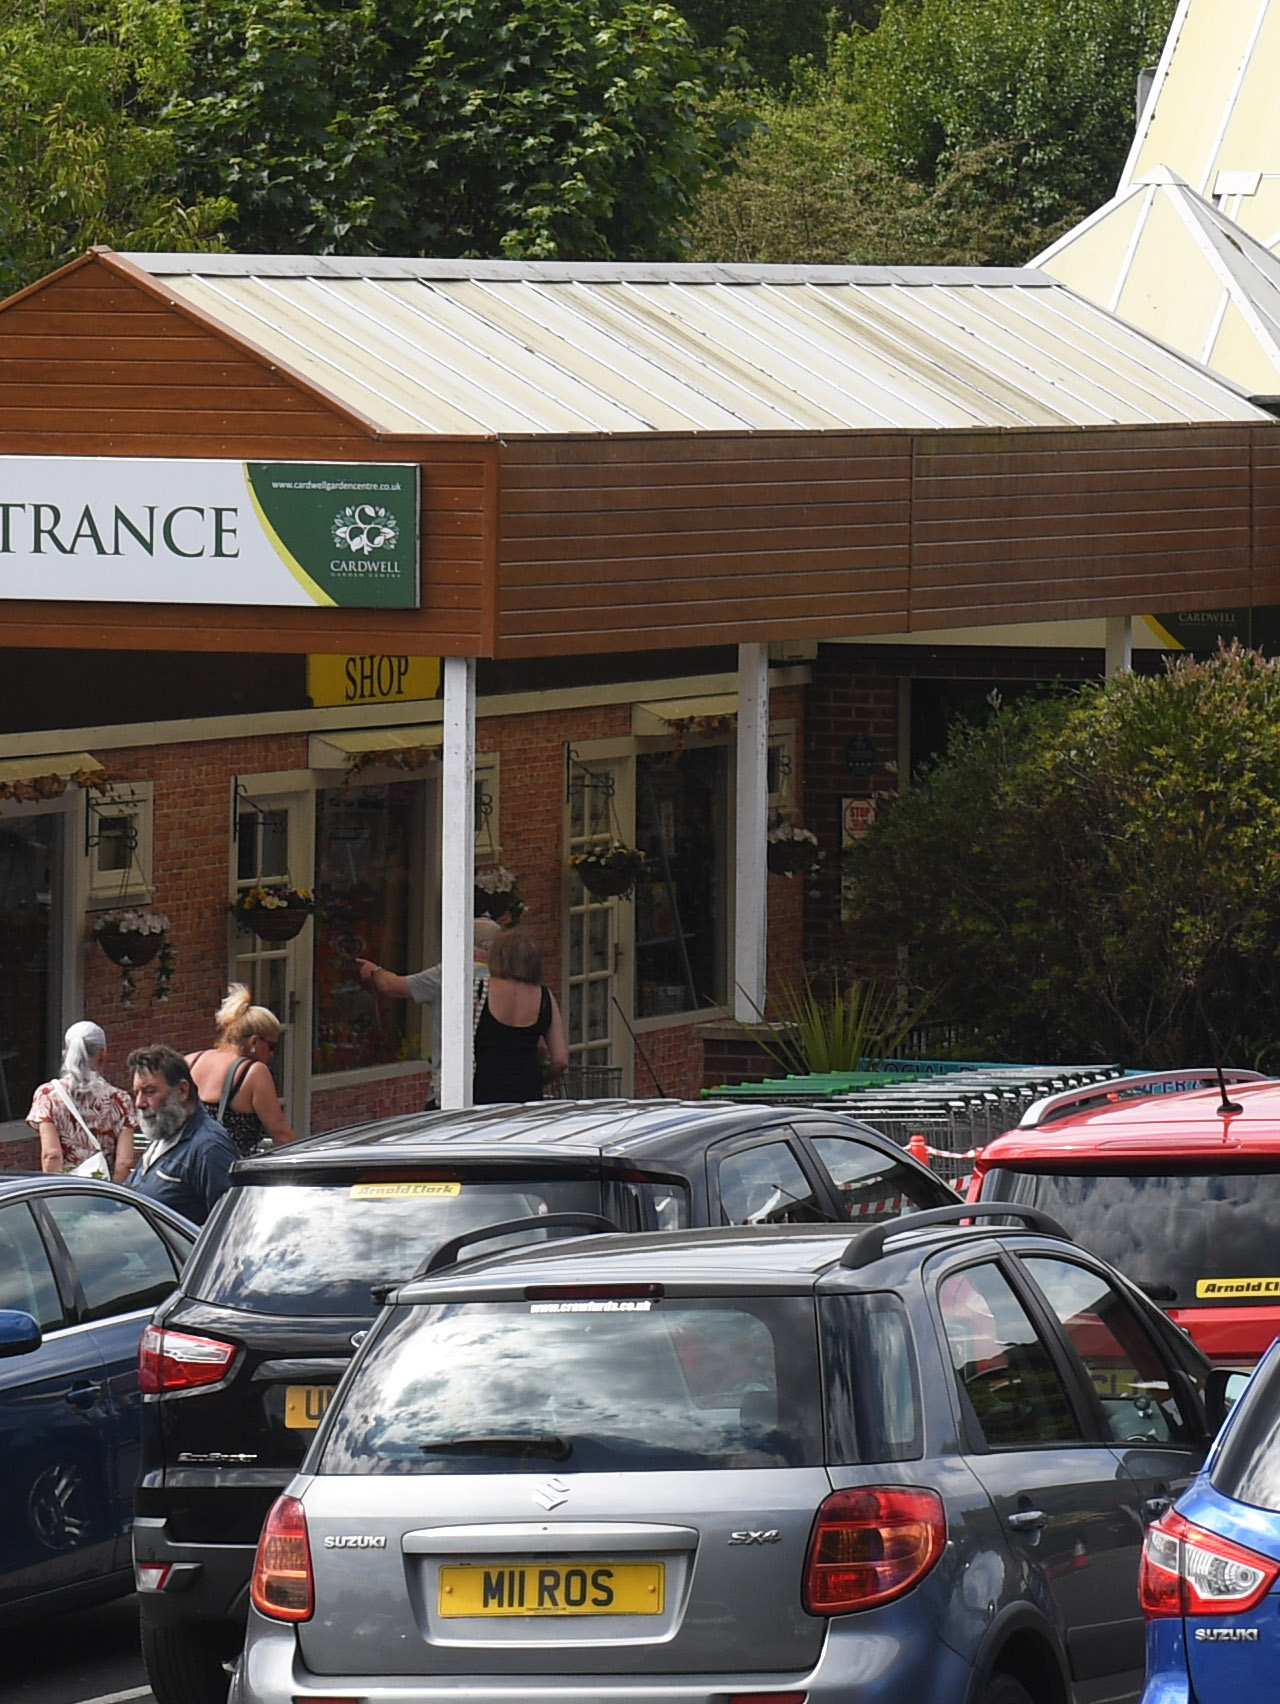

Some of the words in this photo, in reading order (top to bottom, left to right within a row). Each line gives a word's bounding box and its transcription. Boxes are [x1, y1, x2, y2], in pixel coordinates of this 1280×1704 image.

[271, 479, 401, 492] www.cardwellgardencentre.co.uk
[330, 560, 401, 573] CARDWELL
[1178, 612, 1235, 622] CARDWELL
[345, 655, 409, 701] SHOP
[850, 807, 870, 818] STOP
[358, 1185, 410, 1195] Arnold
[413, 1184, 454, 1194] Clark
[1204, 1282, 1262, 1293] Arnold
[324, 1535, 387, 1549] SUZUKI
[728, 1529, 781, 1545] SX4
[537, 1568, 614, 1607] ROS
[1194, 1628, 1259, 1641] SUZUKI
